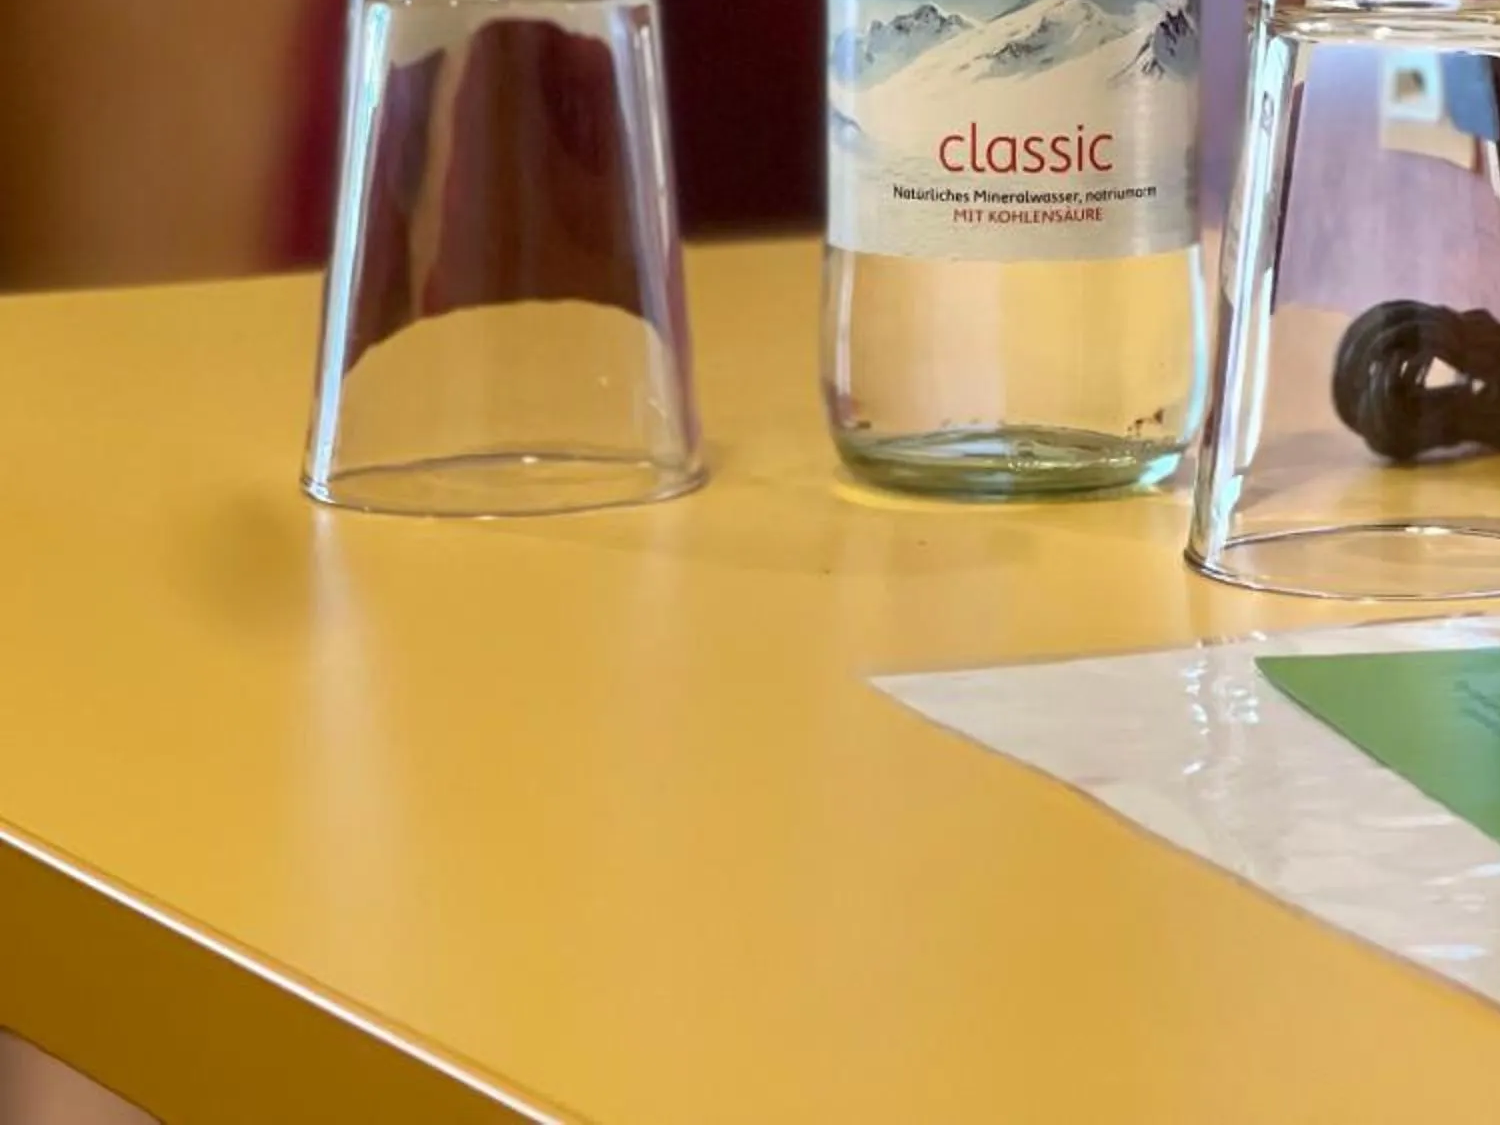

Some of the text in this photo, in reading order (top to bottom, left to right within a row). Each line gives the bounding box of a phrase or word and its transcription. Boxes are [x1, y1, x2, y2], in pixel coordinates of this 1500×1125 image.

[938, 122, 1114, 173] classic
[892, 185, 970, 204] Natürliches
[973, 188, 1083, 205] Mineralwasser,
[952, 206, 1104, 224] MIT KOHLENSÄURE
